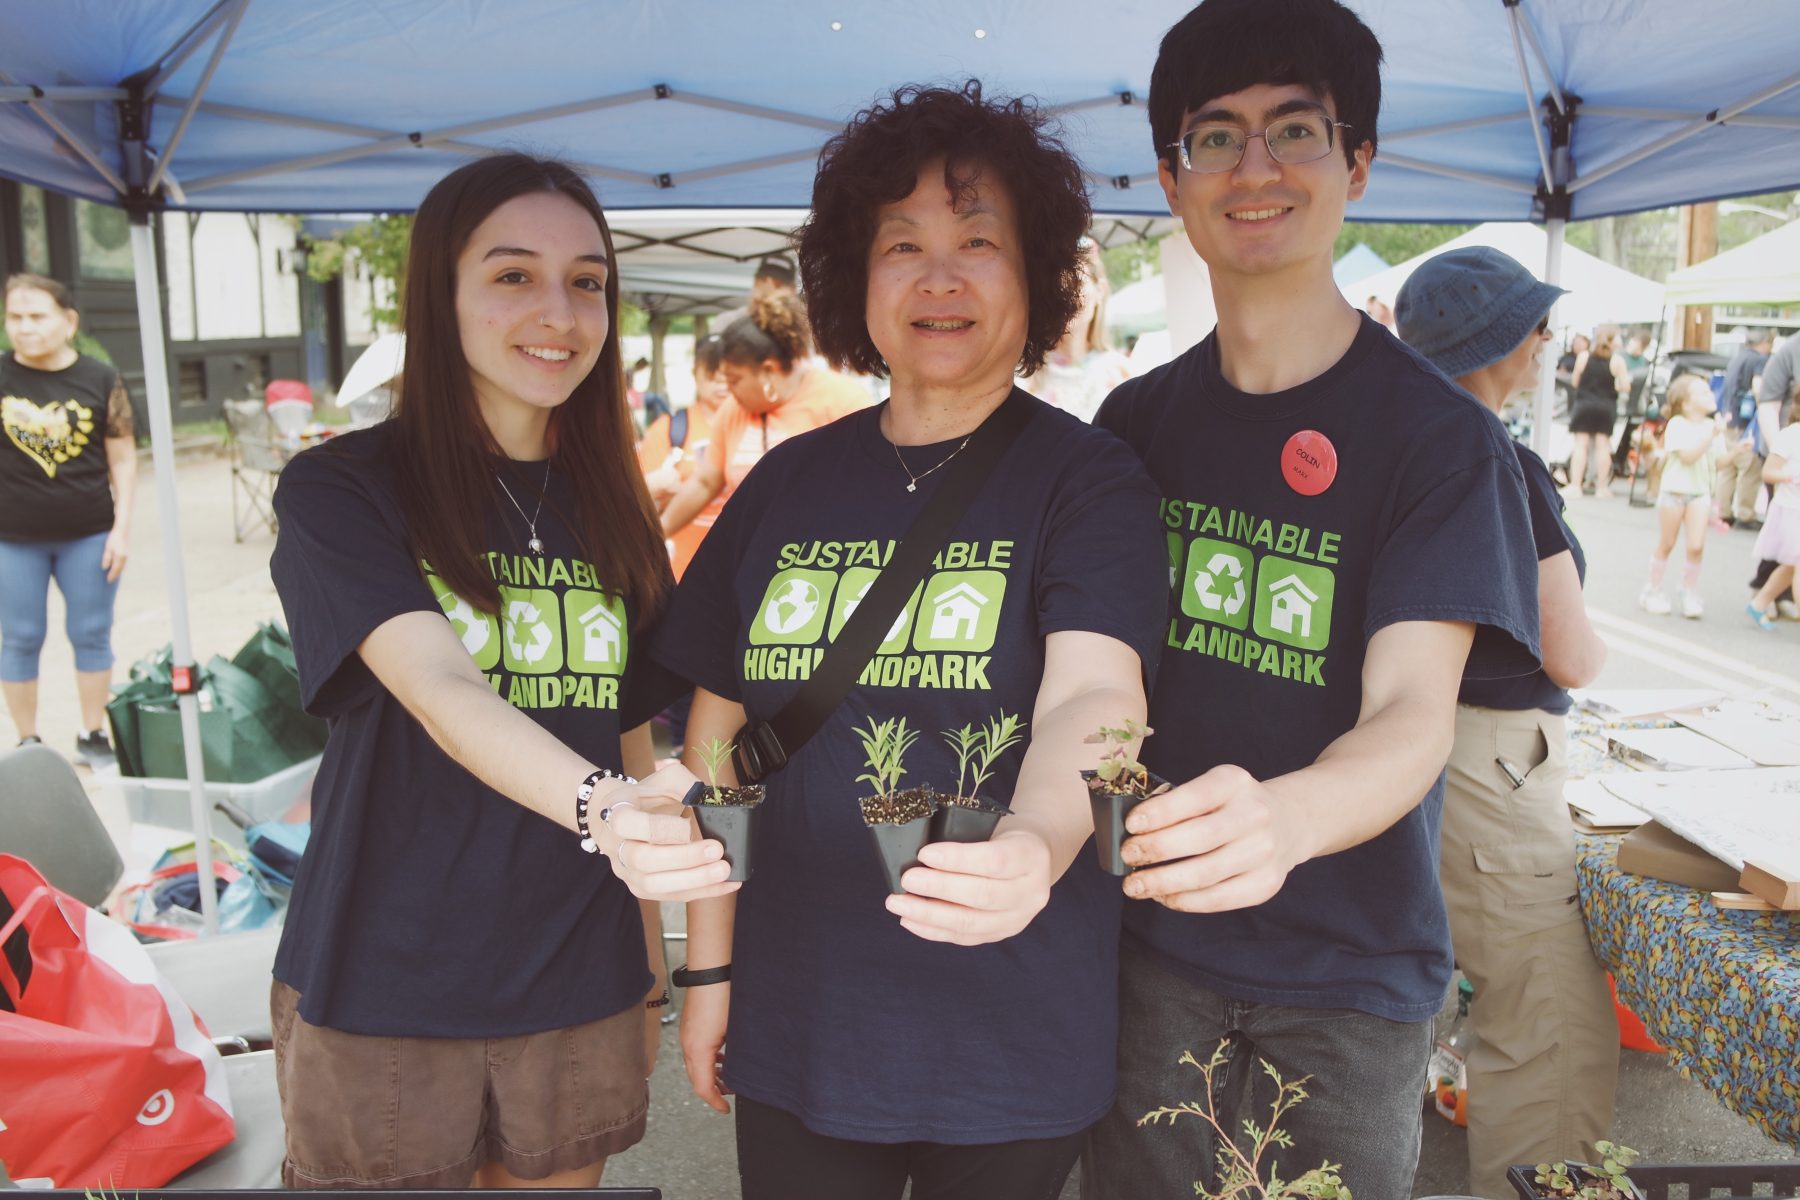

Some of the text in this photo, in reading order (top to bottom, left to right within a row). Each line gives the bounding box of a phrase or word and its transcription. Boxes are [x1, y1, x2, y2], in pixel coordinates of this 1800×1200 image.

[1295, 448, 1321, 469] COLIN
[1159, 497, 1341, 565] STAINABLE
[777, 539, 1014, 569] SUSTAIBLE
[744, 647, 992, 690] HIGHNDPARK
[1167, 617, 1326, 687] LANDPARK
